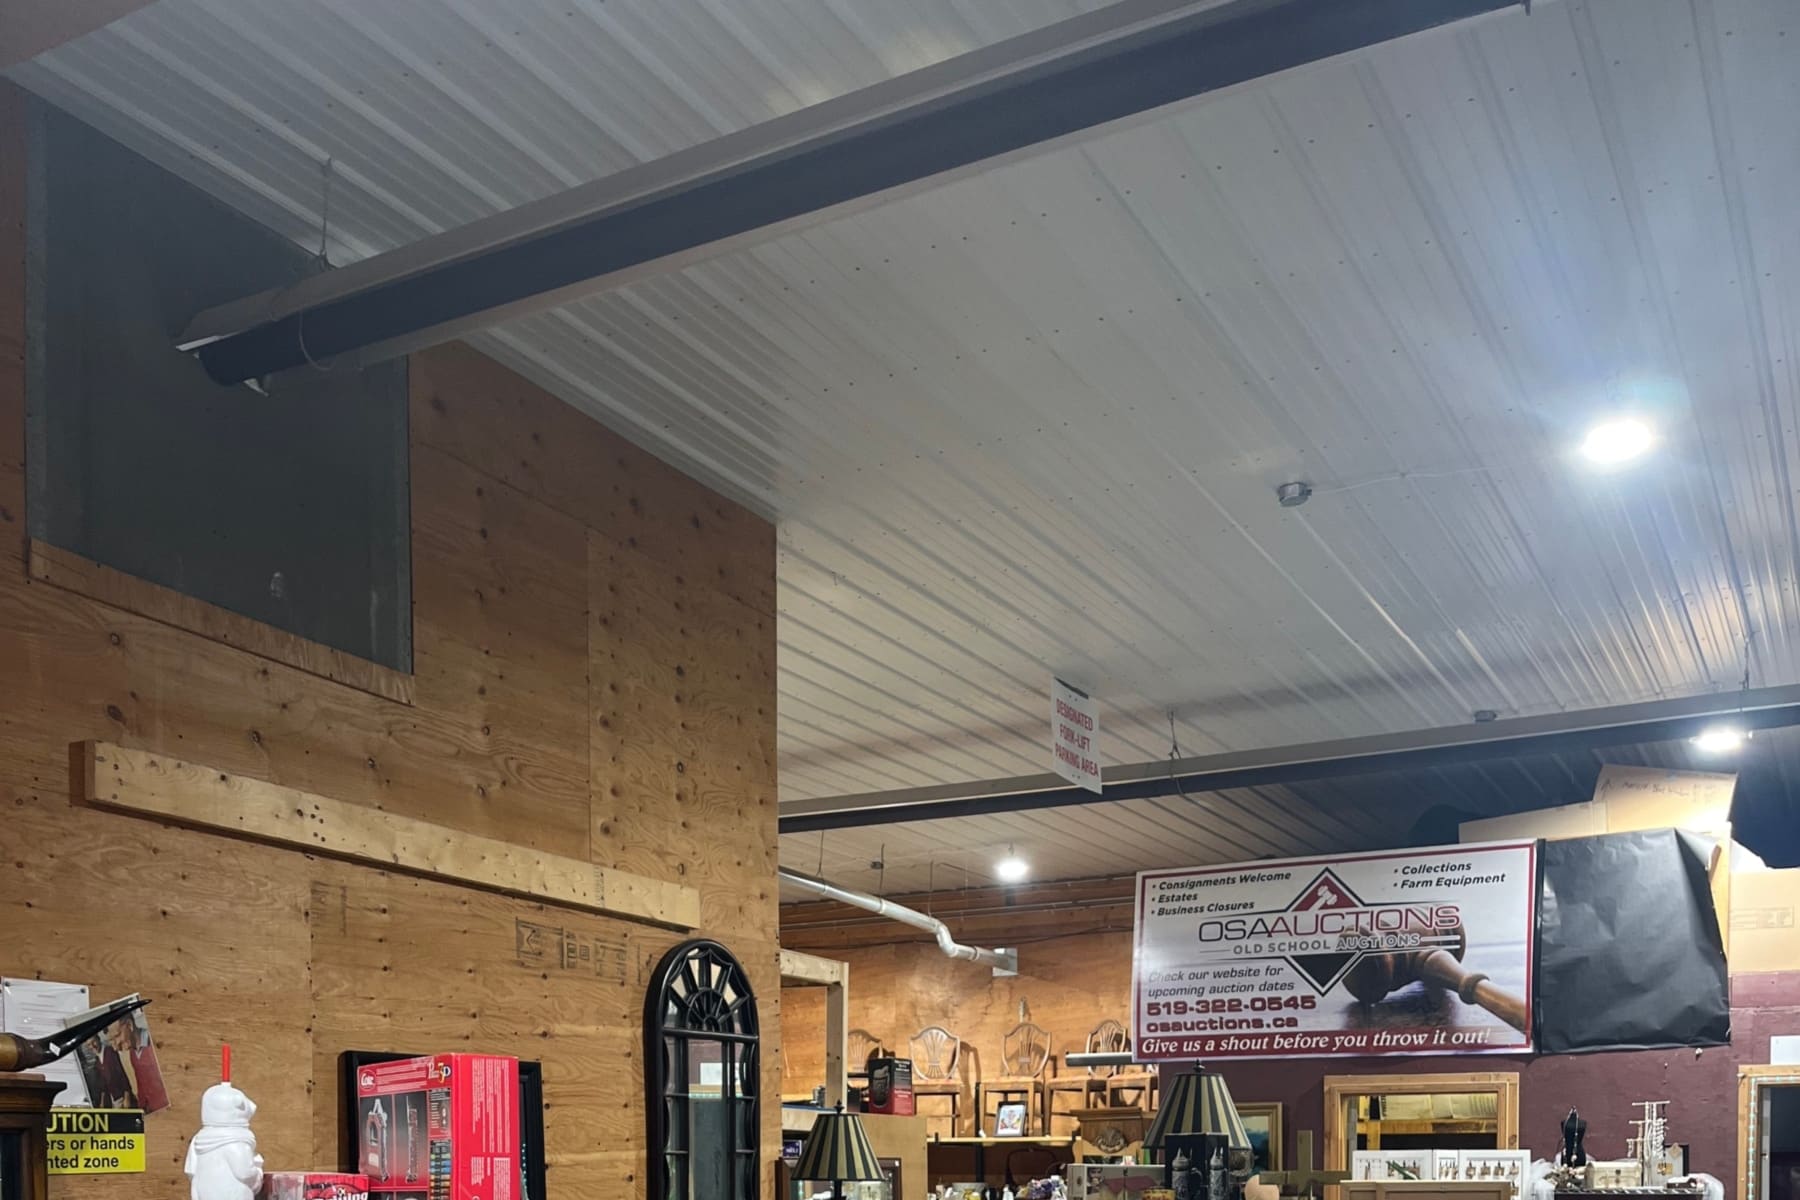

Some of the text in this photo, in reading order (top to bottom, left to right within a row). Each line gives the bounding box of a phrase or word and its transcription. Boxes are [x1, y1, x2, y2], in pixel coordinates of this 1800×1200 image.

[1402, 862, 1472, 875] Collections
[1159, 872, 1291, 890] Consignments Welcome
[1401, 873, 1506, 889] Farm Equipment
[1158, 893, 1198, 903] Estates
[1157, 901, 1254, 916] Business Closures
[1233, 934, 1420, 955] OLD SCHOOL AUCTIONS
[1149, 965, 1284, 983] Check our website for
[1148, 981, 1295, 999] upcoming auction dates
[1147, 995, 1316, 1016] 519-322-0545
[1147, 1017, 1298, 1032] osauctions.ca
[1143, 1028, 1492, 1053] Give us a shout before you throw it out!
[70, 1139, 86, 1150] or
[90, 1136, 135, 1150] hands
[83, 1157, 119, 1168] zone
